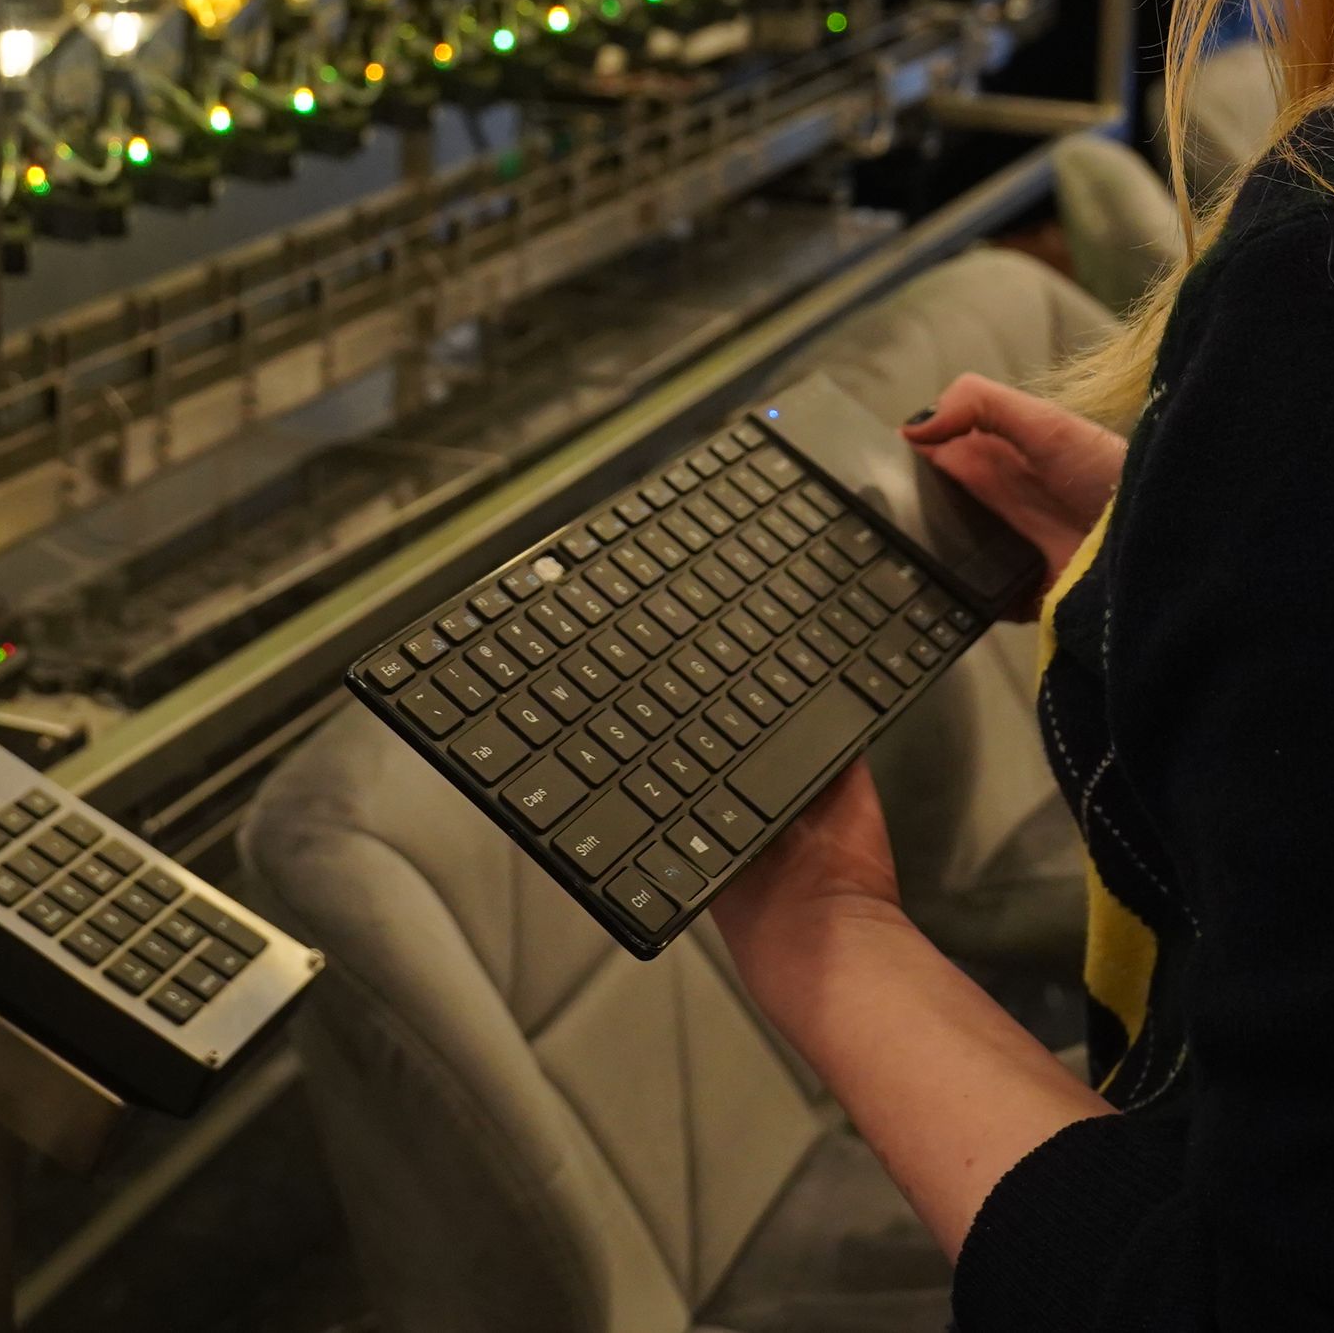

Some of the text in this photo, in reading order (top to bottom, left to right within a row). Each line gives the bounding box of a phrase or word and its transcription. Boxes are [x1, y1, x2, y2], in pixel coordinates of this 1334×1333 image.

[380, 662, 401, 677] Esc
[408, 641, 421, 652] F1
[442, 619, 456, 630] F2
[448, 668, 460, 678] !
[479, 645, 493, 658] @
[468, 685, 482, 698] 1
[498, 662, 515, 677] 2
[529, 641, 545, 654] 3
[560, 620, 573, 632] 4
[586, 600, 601, 614] 5
[613, 582, 629, 595] 6
[471, 745, 493, 761] Tab
[522, 709, 540, 723] Q
[550, 685, 569, 701] W
[581, 665, 598, 679] E
[609, 644, 626, 657] R
[636, 623, 651, 636] T
[522, 788, 548, 807] Caps
[580, 750, 596, 764] A
[609, 726, 625, 739] S
[636, 704, 652, 717] D
[664, 681, 677, 695] F
[690, 660, 706, 674] G
[575, 835, 601, 857] Shift
[643, 782, 661, 797] Z
[671, 758, 688, 773] X
[699, 736, 714, 749] C
[723, 713, 739, 726] V
[749, 692, 765, 706] B
[631, 889, 652, 908] Ctrl
[722, 810, 738, 824] Alt
